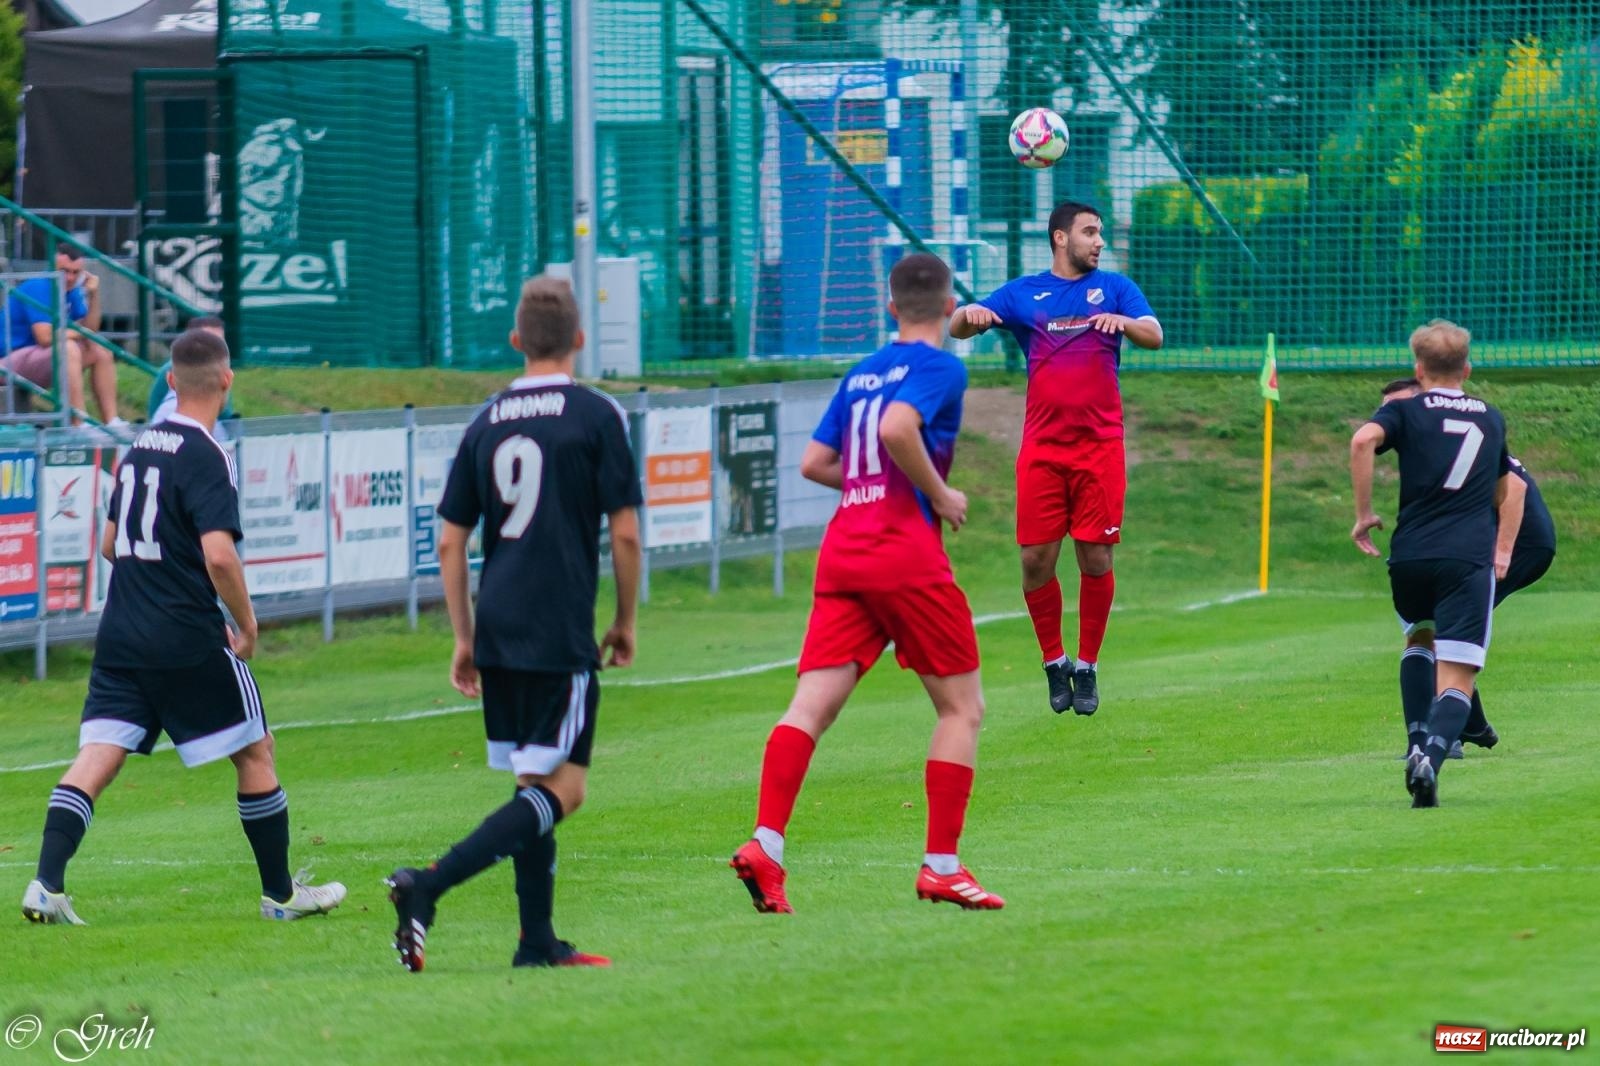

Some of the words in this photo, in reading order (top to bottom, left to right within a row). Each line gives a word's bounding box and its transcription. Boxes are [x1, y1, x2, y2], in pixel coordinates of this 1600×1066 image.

[847, 393, 884, 480] 11
[1443, 418, 1484, 490] 7
[114, 463, 162, 561] 11
[493, 434, 543, 538] 9
